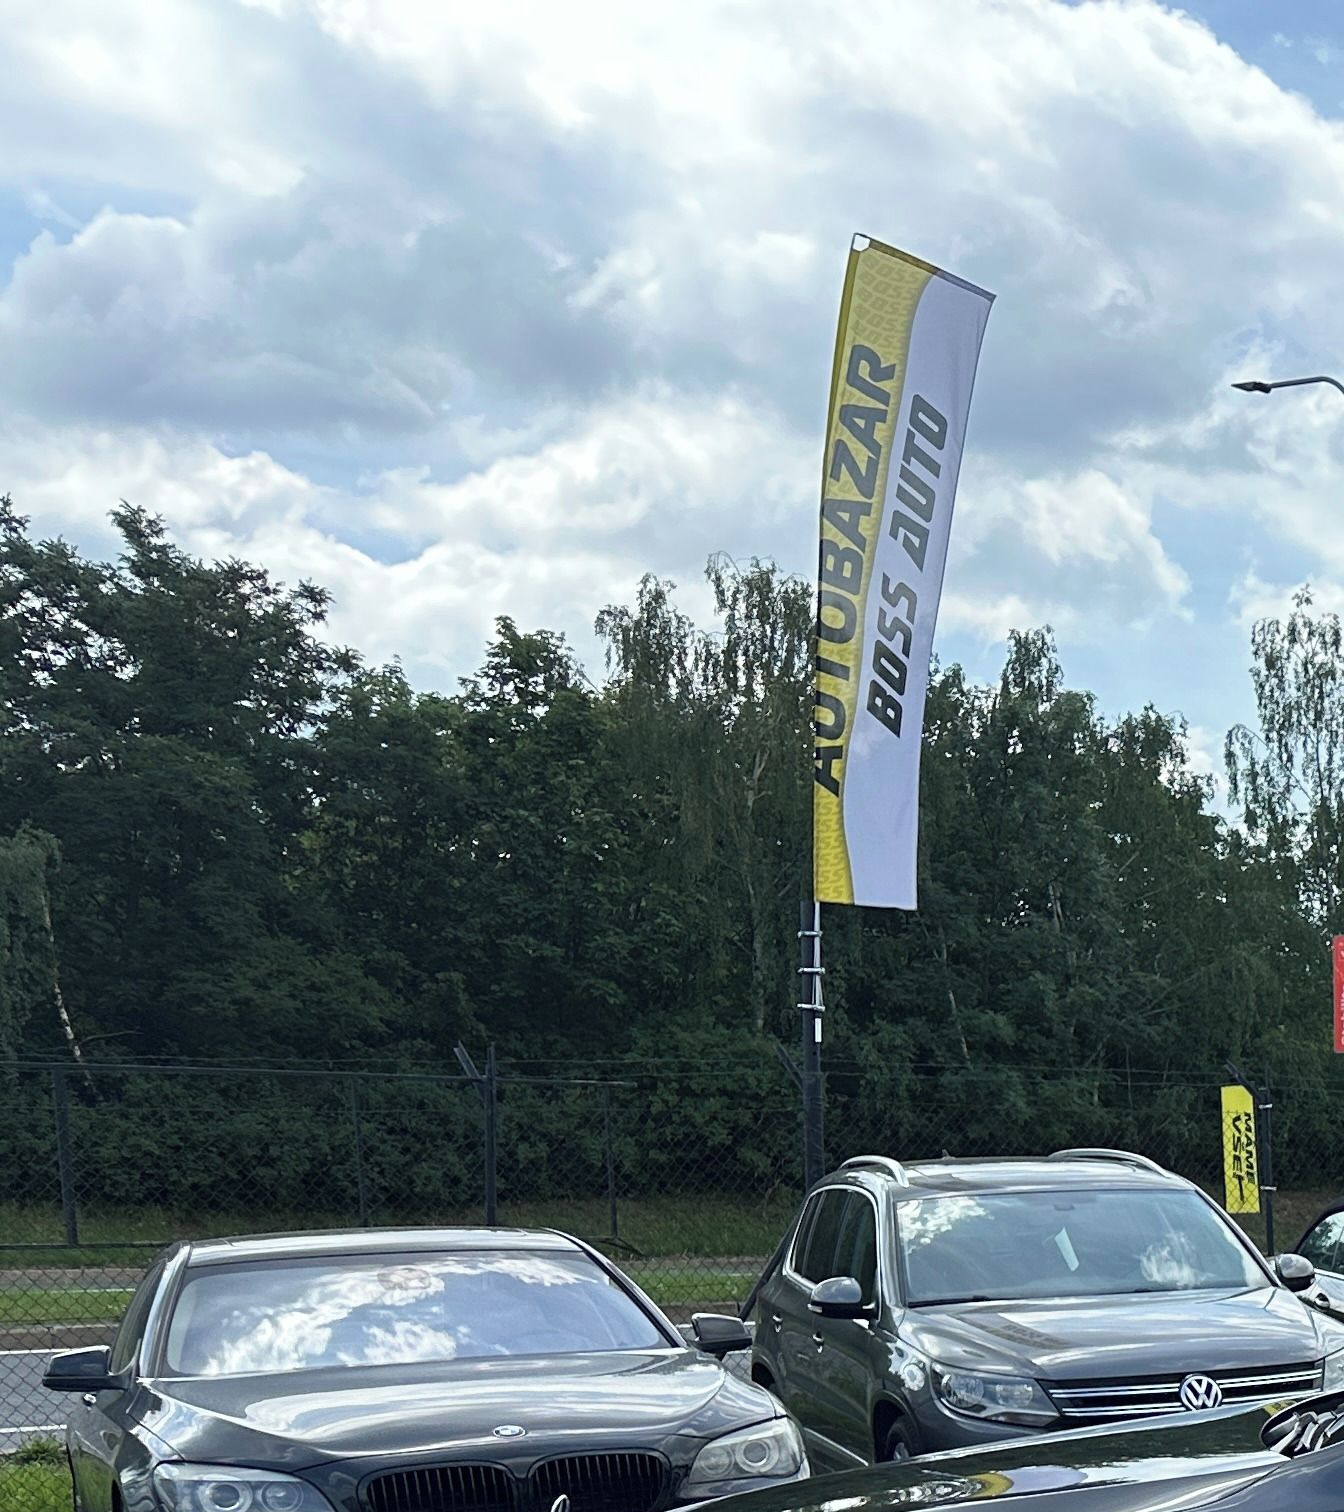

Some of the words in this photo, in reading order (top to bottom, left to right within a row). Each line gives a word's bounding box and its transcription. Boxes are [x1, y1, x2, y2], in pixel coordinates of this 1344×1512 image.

[815, 344, 896, 797] AUTOBAZAR
[889, 394, 947, 571] AUTO
[867, 572, 917, 738] BOSS
